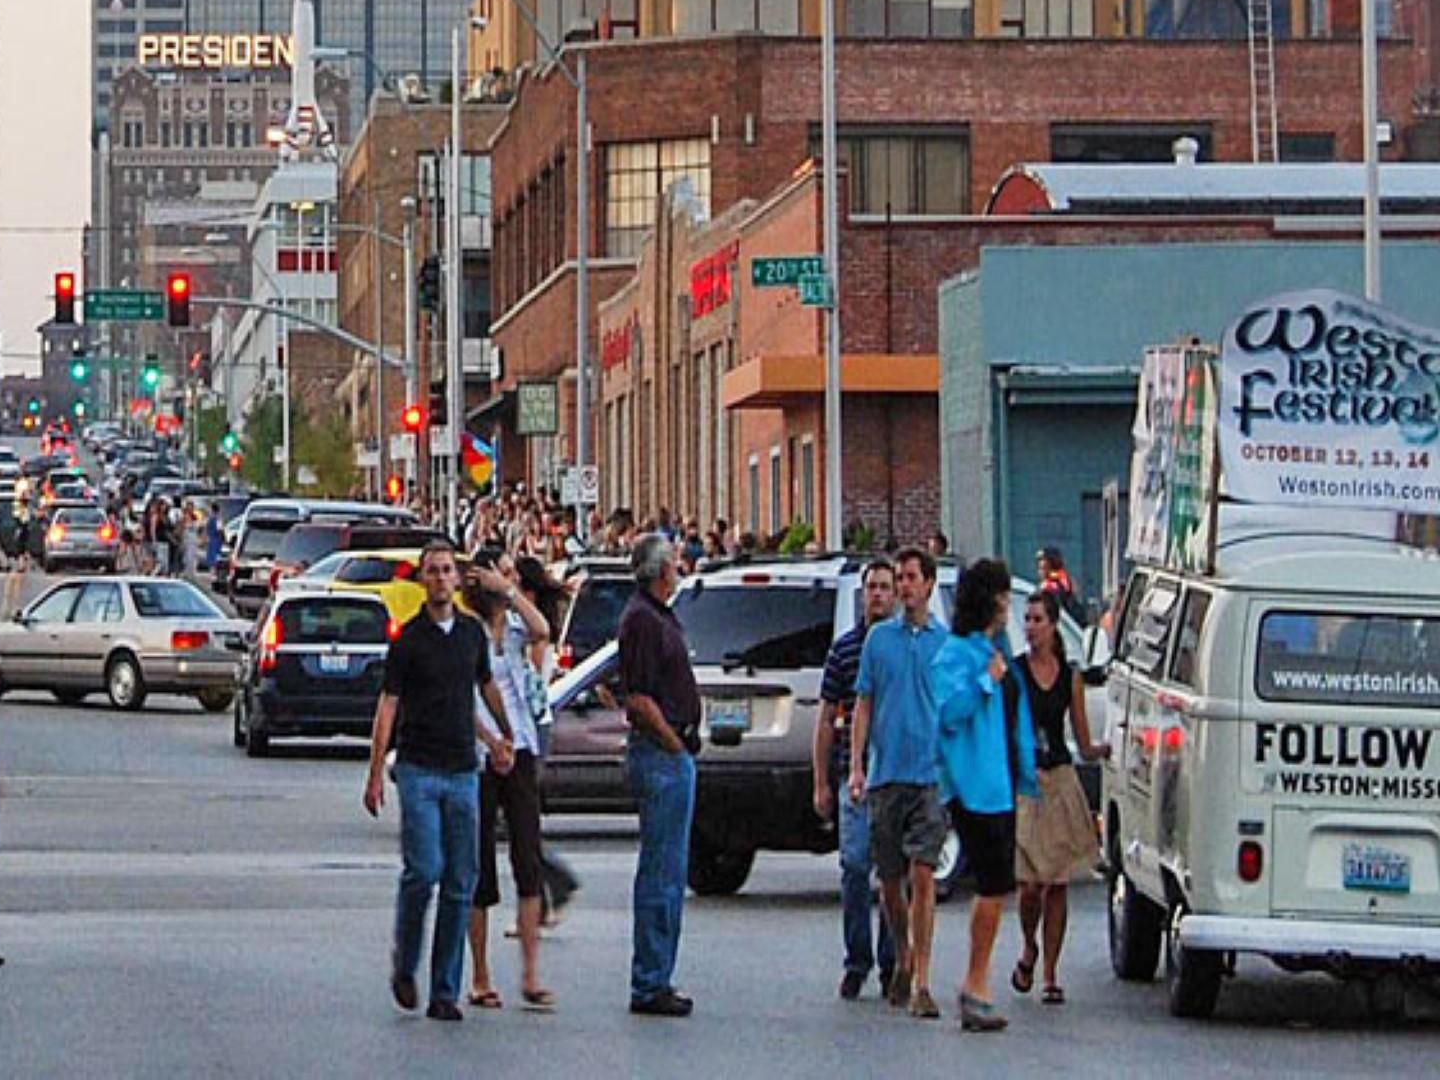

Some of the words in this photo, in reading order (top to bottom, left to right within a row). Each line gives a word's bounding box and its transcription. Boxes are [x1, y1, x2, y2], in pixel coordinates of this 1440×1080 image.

[140, 35, 294, 67] PRESIDEN
[1241, 443, 1327, 464] OCTOBER
[1408, 451, 1429, 468] 14
[1255, 723, 1432, 770] FOLLOW
[1281, 771, 1369, 797] WESTON
